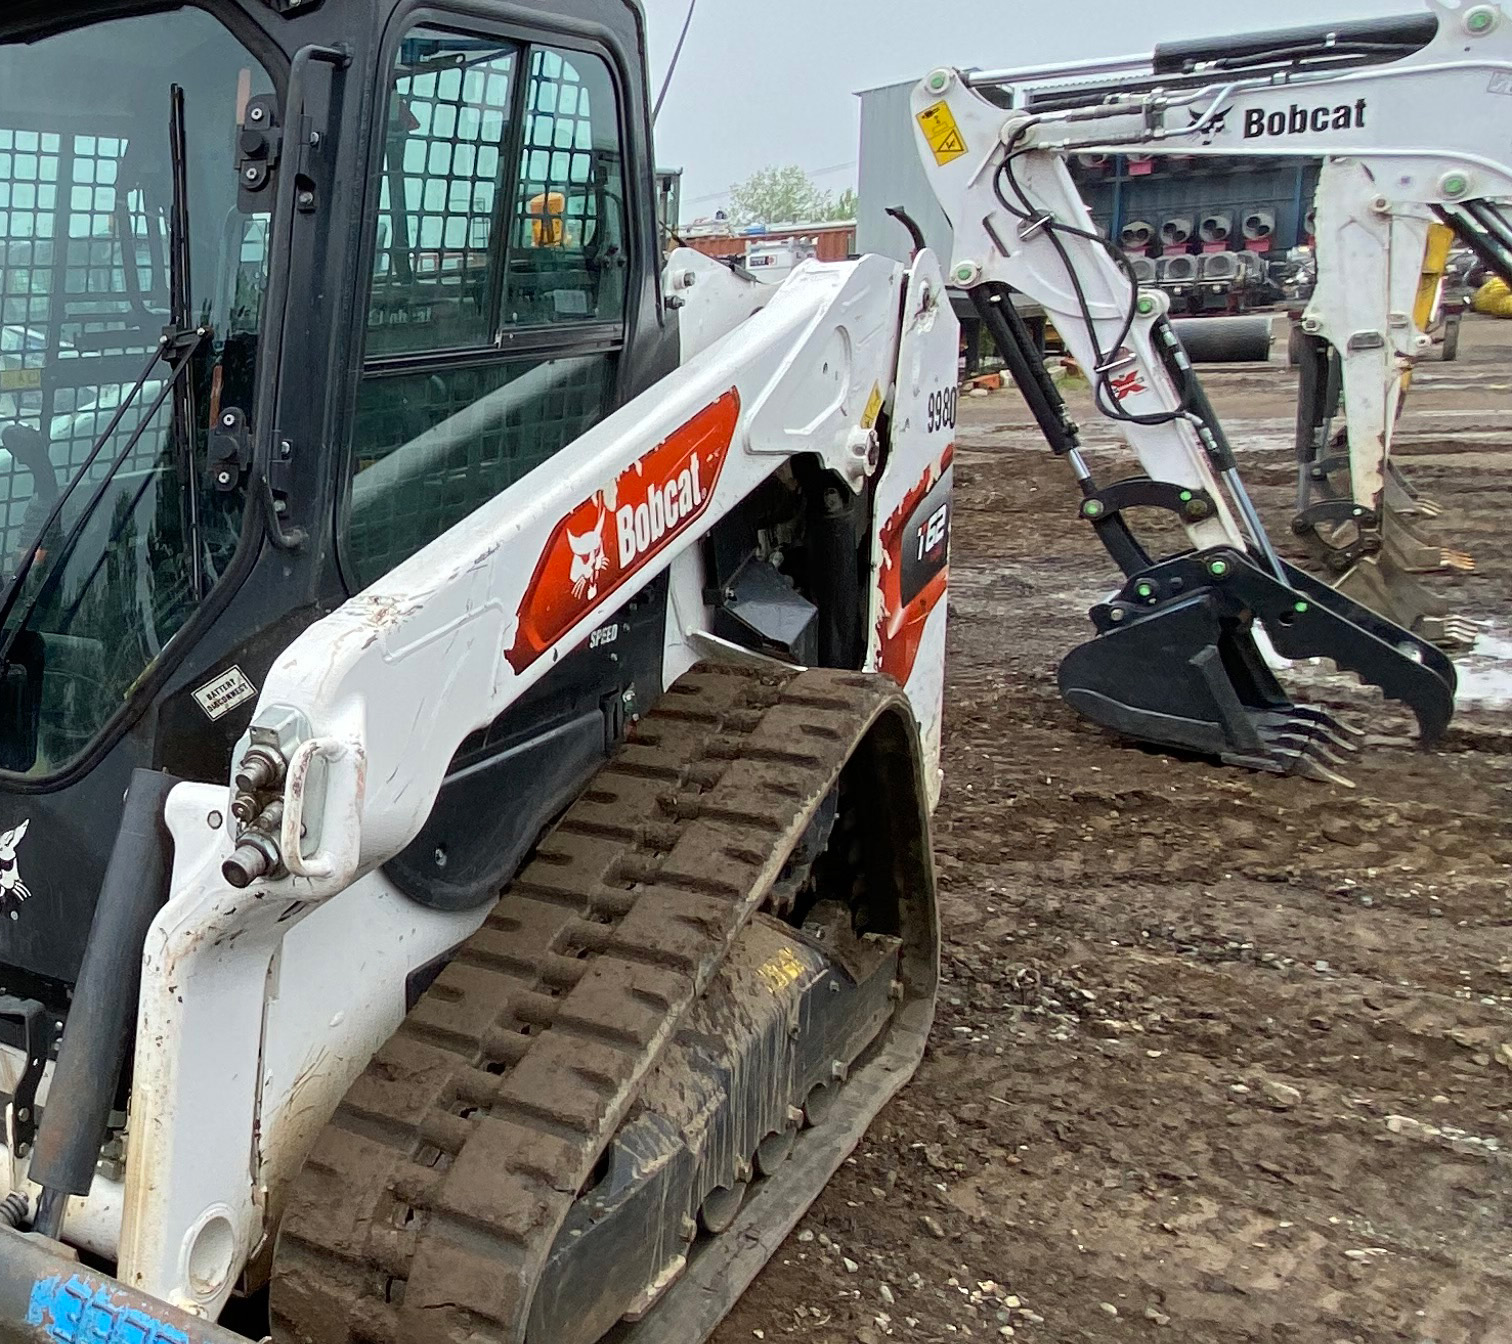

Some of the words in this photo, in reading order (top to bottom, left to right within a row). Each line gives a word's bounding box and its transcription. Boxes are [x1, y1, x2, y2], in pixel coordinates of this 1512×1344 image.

[1243, 98, 1366, 139] Bobcat
[927, 386, 957, 433] 9980
[616, 451, 701, 569] Bobcat
[589, 623, 618, 649] SPEED
[205, 678, 237, 701] BATTERY
